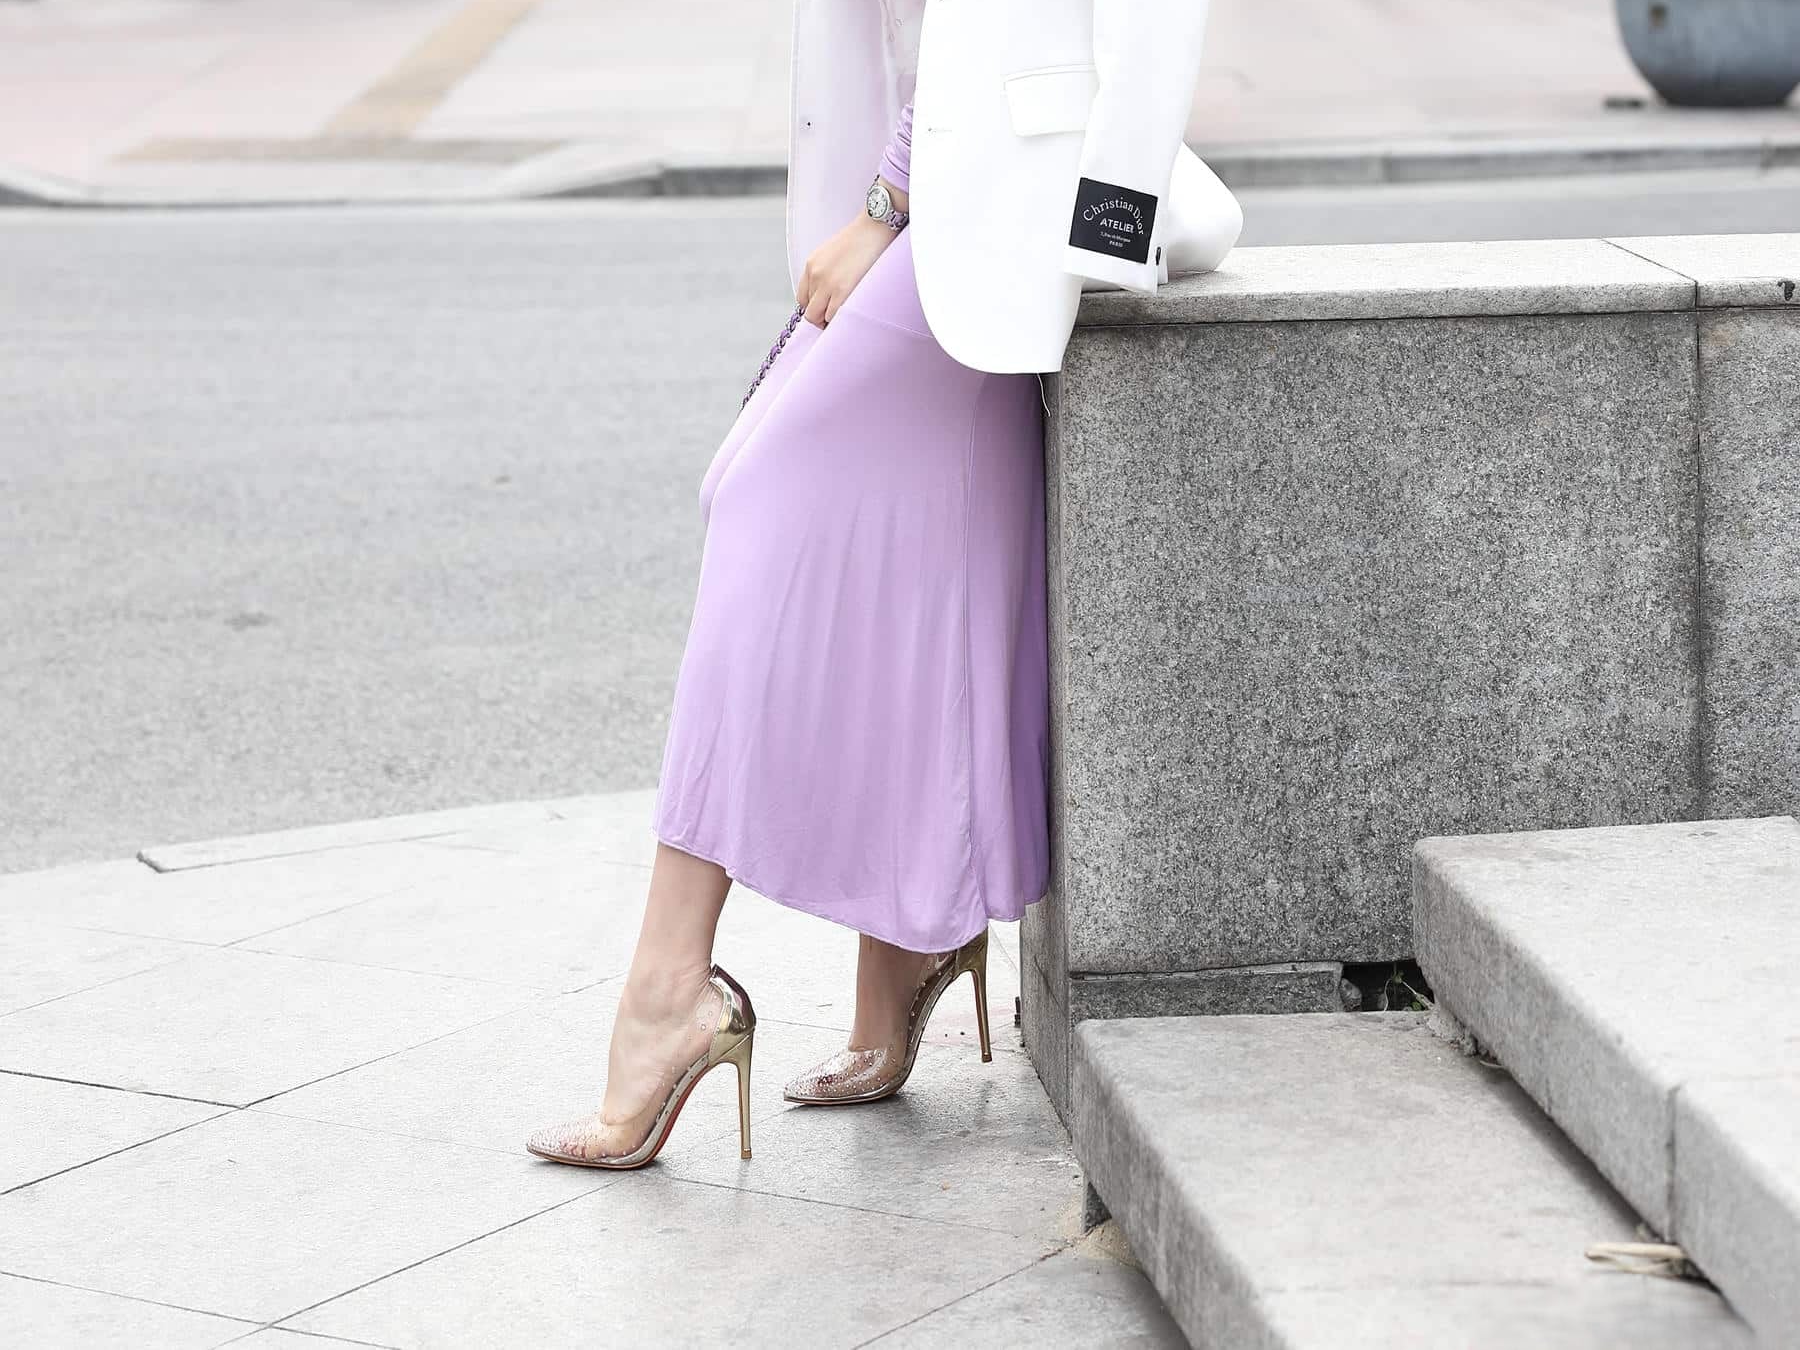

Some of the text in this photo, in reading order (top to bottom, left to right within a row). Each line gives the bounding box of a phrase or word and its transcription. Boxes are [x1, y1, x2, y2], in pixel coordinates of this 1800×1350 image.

[1083, 196, 1144, 235] Christian Dior
[1100, 217, 1134, 234] ATELIER
